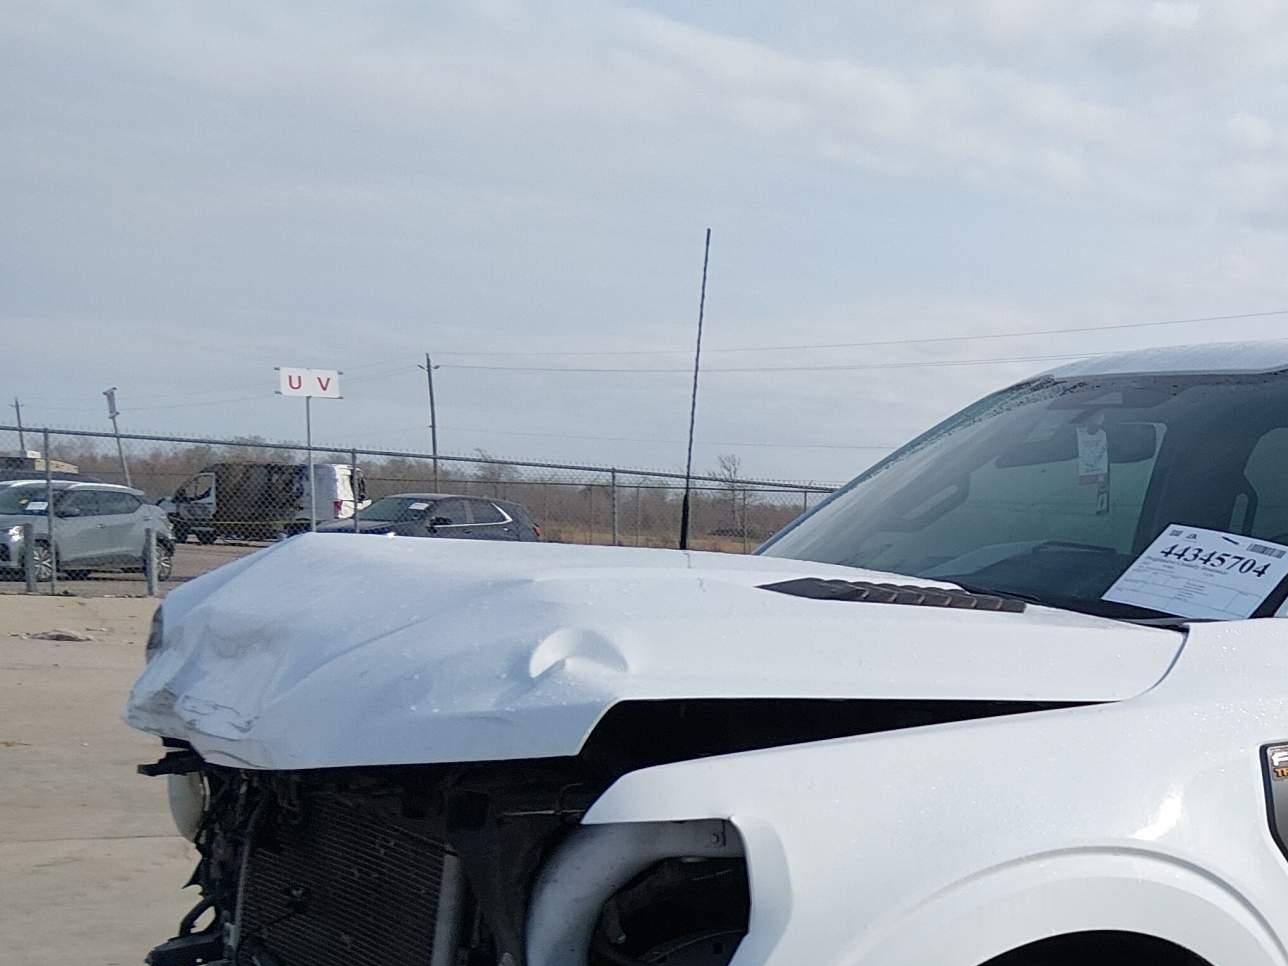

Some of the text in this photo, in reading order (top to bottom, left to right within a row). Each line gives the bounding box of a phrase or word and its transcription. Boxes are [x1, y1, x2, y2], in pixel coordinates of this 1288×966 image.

[288, 375, 331, 391] U V
[1160, 544, 1272, 578] 44345704
